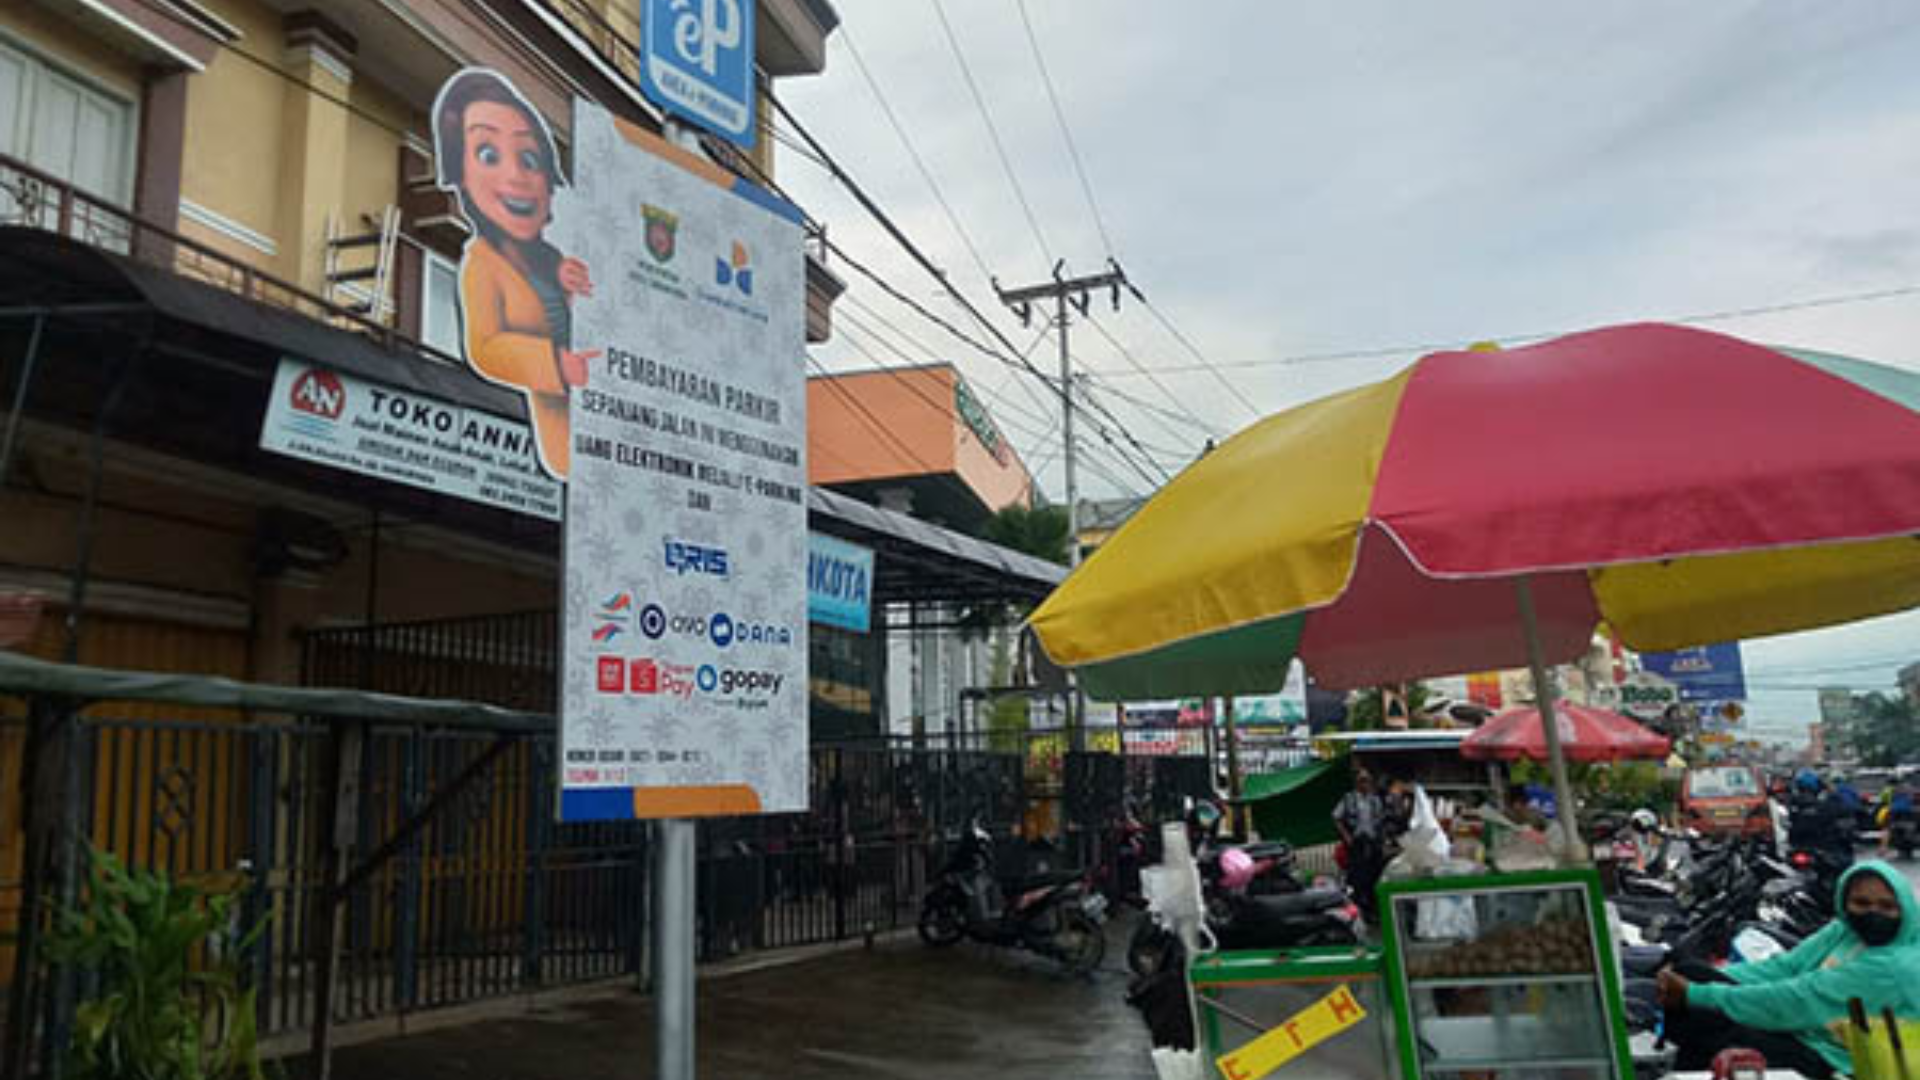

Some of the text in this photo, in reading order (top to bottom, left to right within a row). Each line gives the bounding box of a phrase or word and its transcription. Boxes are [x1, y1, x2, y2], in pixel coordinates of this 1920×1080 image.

[607, 347, 780, 425] PEMBAYARAN PARKIR
[369, 391, 452, 432] TOKO
[581, 389, 657, 429] SEPANJANG
[660, 411, 697, 439] JALAN
[576, 434, 611, 461] UANG
[617, 442, 695, 479] ELEKTRONIK
[720, 668, 784, 696] gopay
